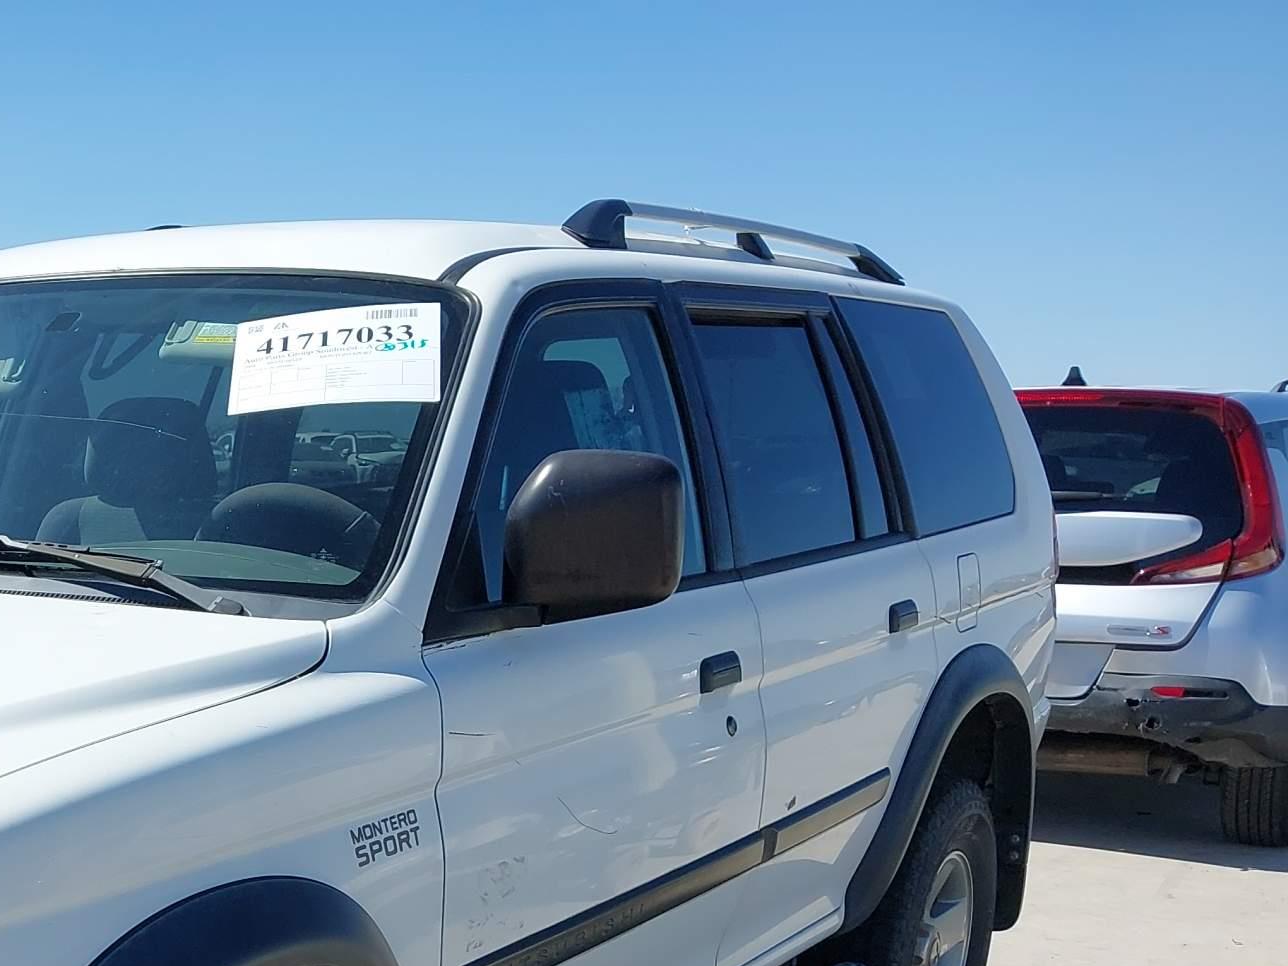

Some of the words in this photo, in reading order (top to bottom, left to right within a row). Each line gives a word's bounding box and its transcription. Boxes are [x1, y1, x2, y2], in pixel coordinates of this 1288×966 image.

[256, 324, 414, 354] 41717033
[349, 808, 418, 845] MONTERO
[354, 826, 420, 868] SPORT
